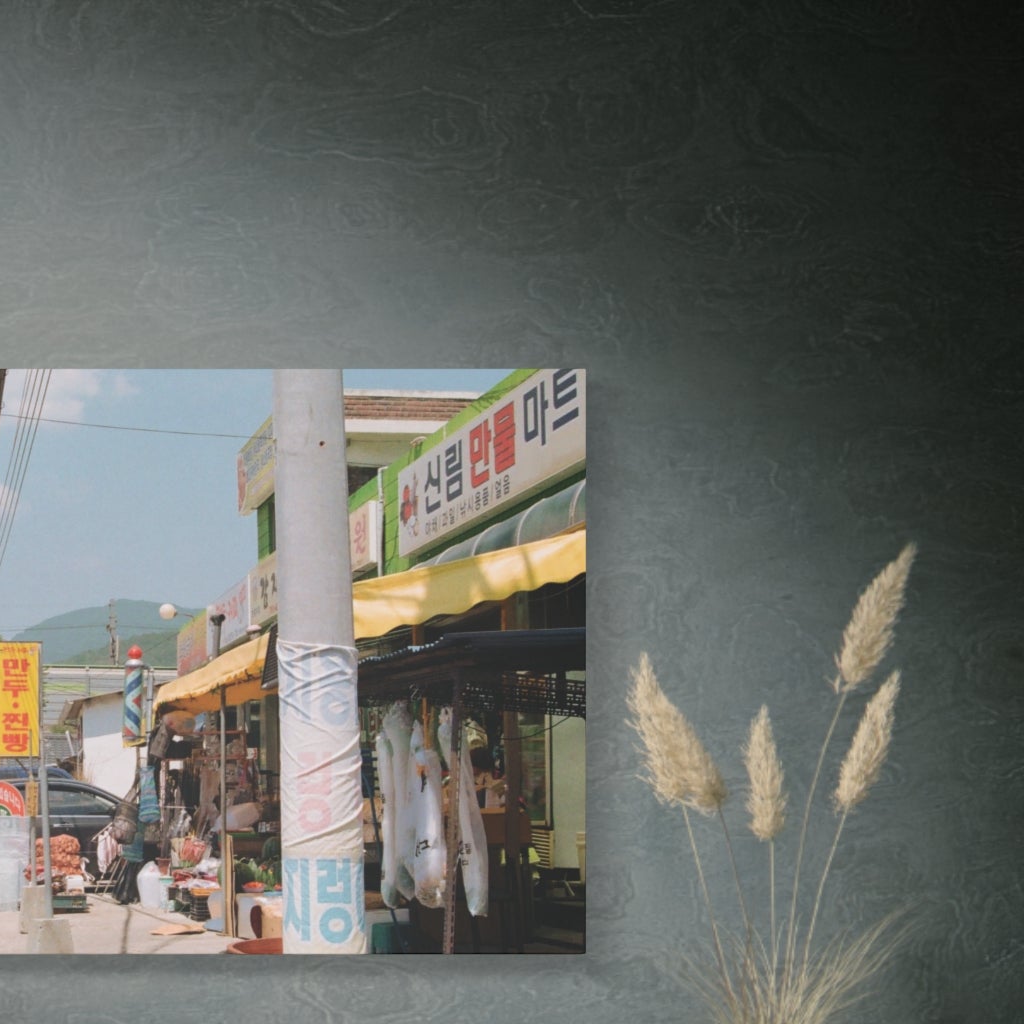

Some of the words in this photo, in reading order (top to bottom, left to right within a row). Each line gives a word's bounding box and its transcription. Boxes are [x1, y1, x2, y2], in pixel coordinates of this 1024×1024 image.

[423, 438, 463, 515] 신림
[469, 401, 516, 489] 만물
[523, 369, 579, 446] 마트
